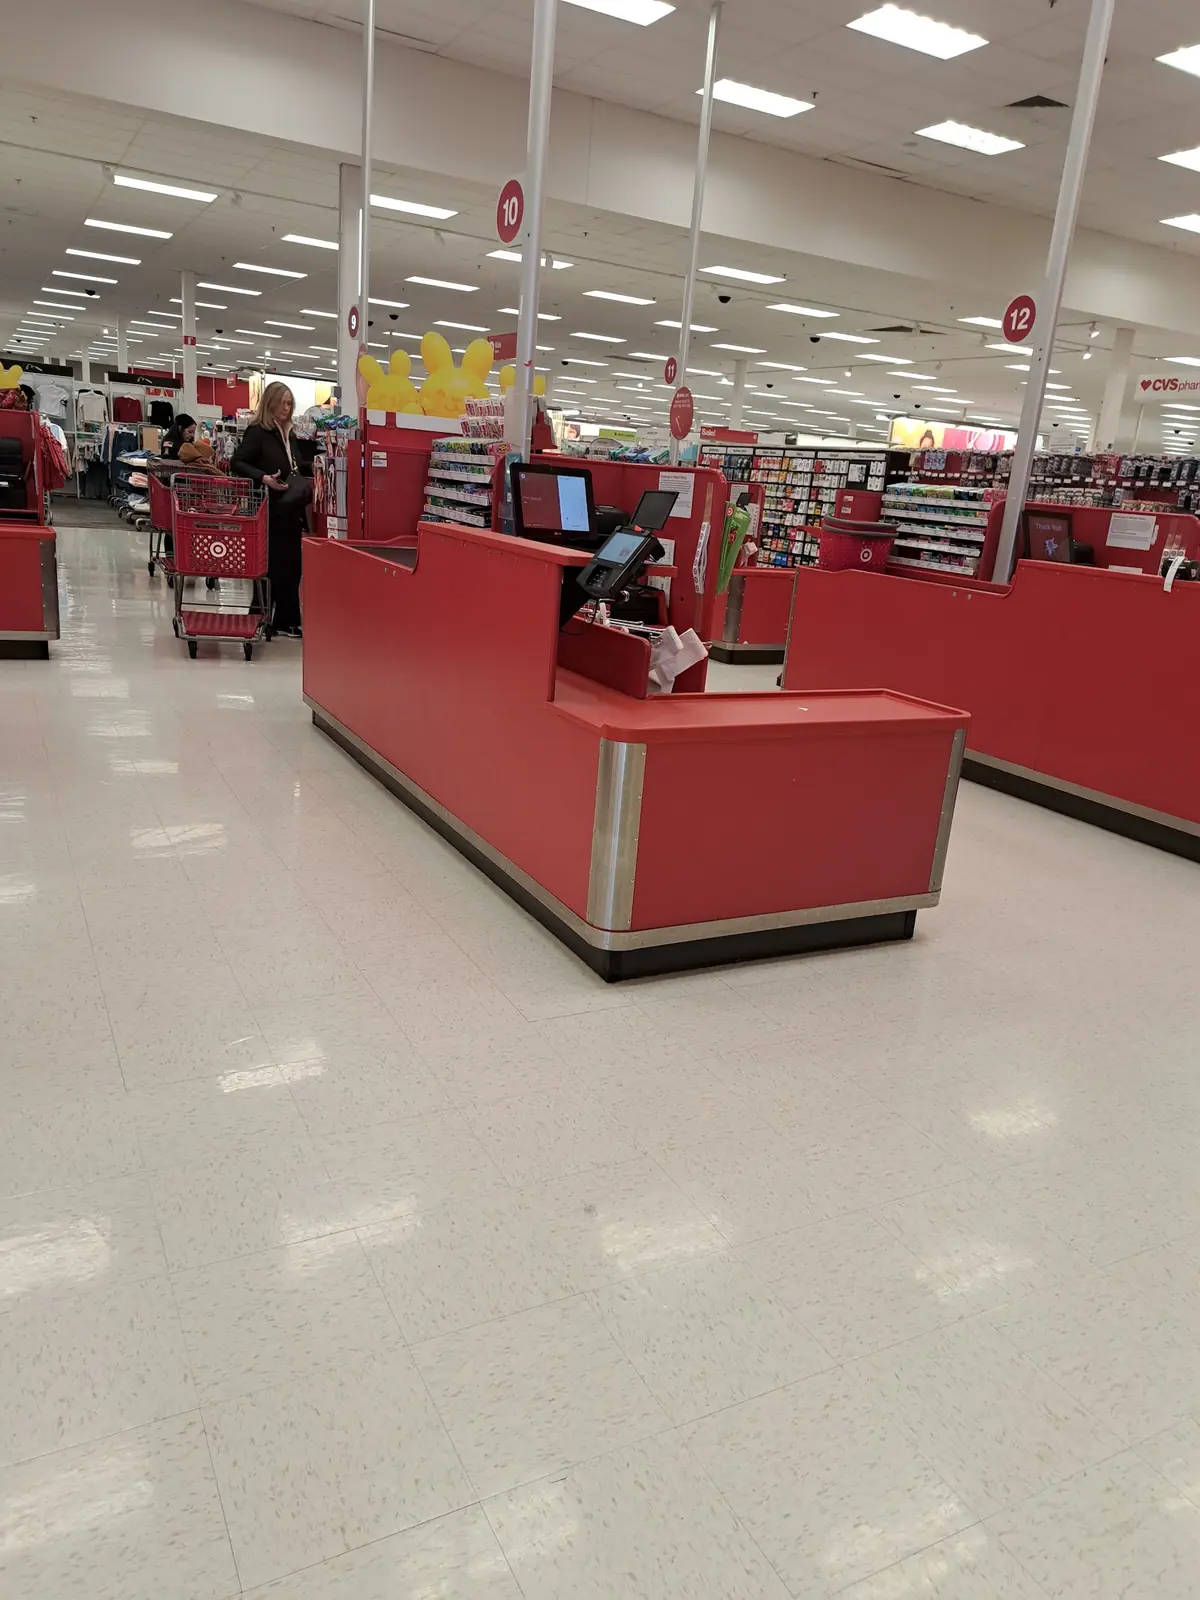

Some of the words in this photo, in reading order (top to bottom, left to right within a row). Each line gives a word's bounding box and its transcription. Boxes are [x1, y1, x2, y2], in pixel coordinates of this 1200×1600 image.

[503, 196, 518, 226] 10
[350, 314, 357, 330] 9
[1010, 307, 1031, 330] 12
[667, 364, 675, 378] 11
